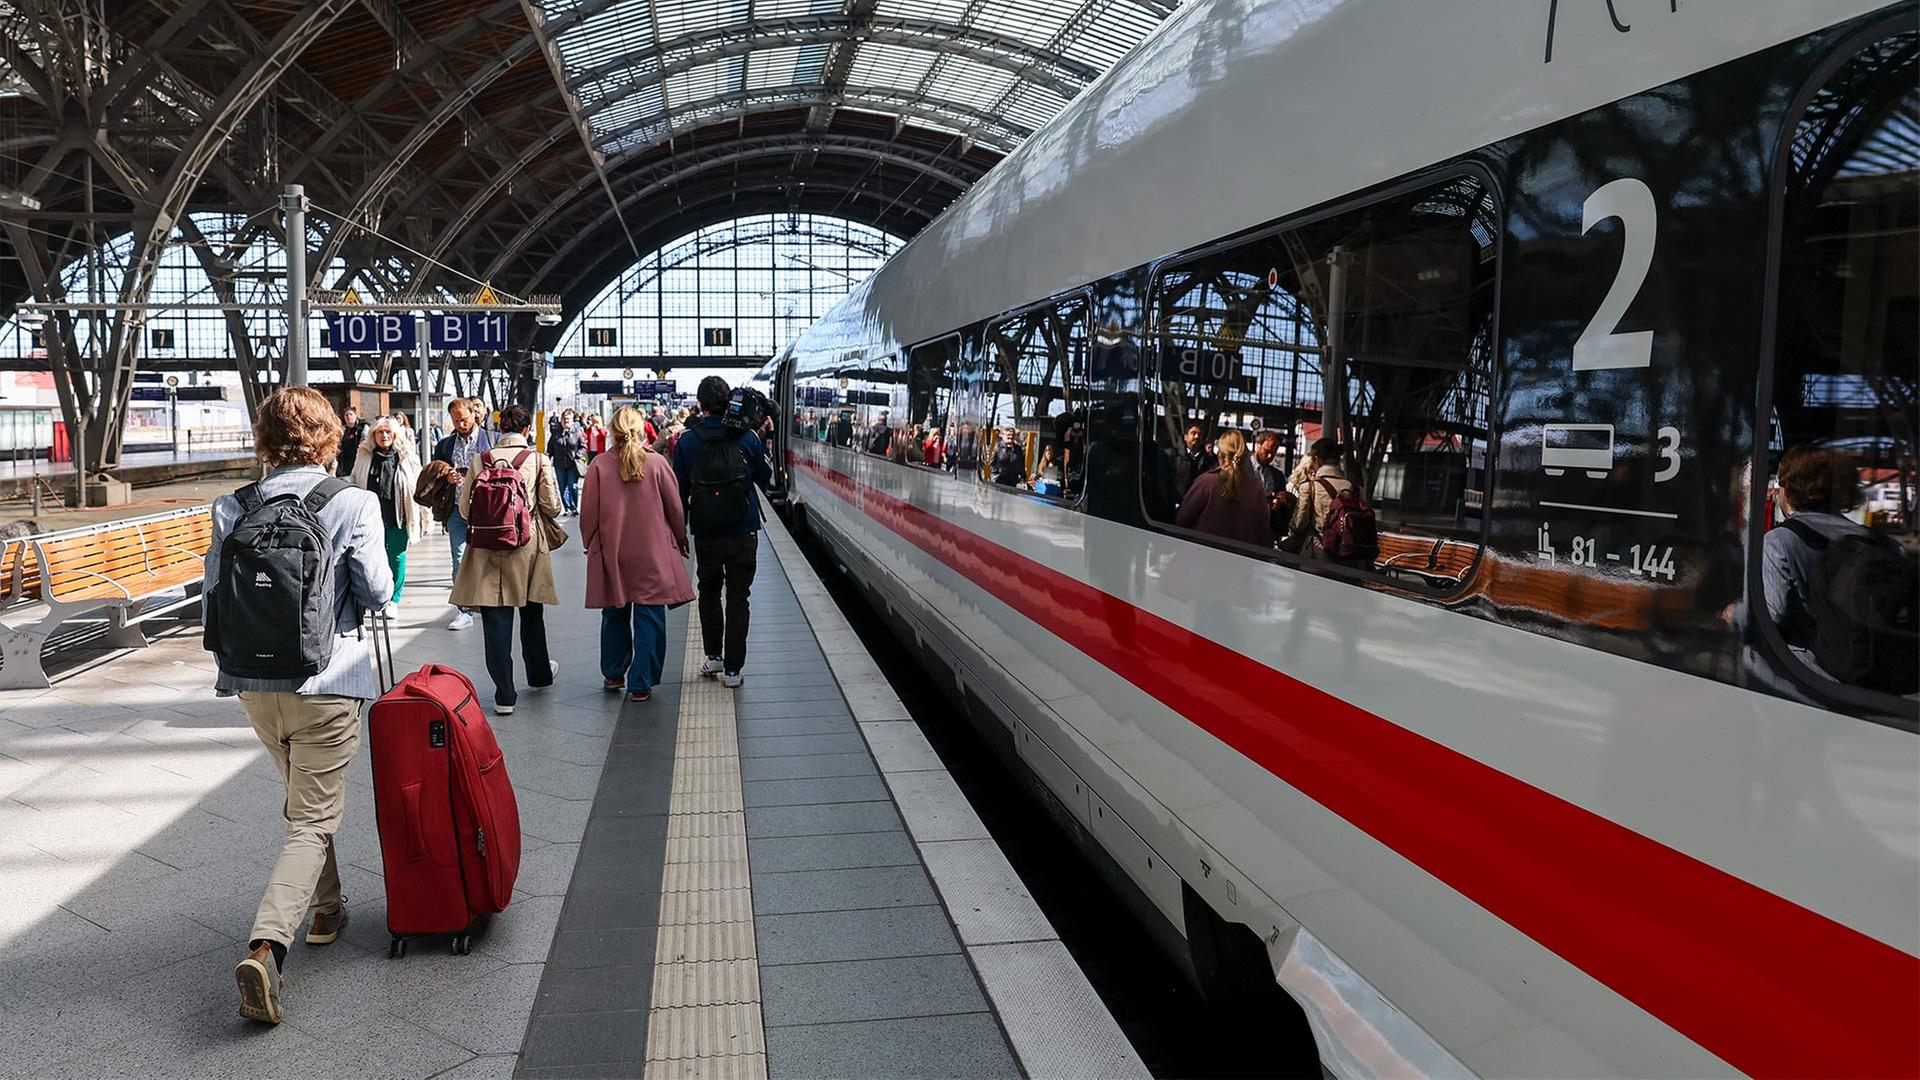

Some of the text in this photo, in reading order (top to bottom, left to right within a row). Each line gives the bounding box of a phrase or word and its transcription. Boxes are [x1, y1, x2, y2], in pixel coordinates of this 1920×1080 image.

[1572, 177, 1658, 371] 2
[159, 331, 165, 346] 7
[333, 316, 403, 343] 10 B
[443, 316, 502, 343] B 11
[596, 330, 609, 345] 10
[712, 329, 724, 345] 11
[1654, 426, 1681, 483] 3
[1571, 535, 1597, 569] 81
[1629, 544, 1676, 581] 144
